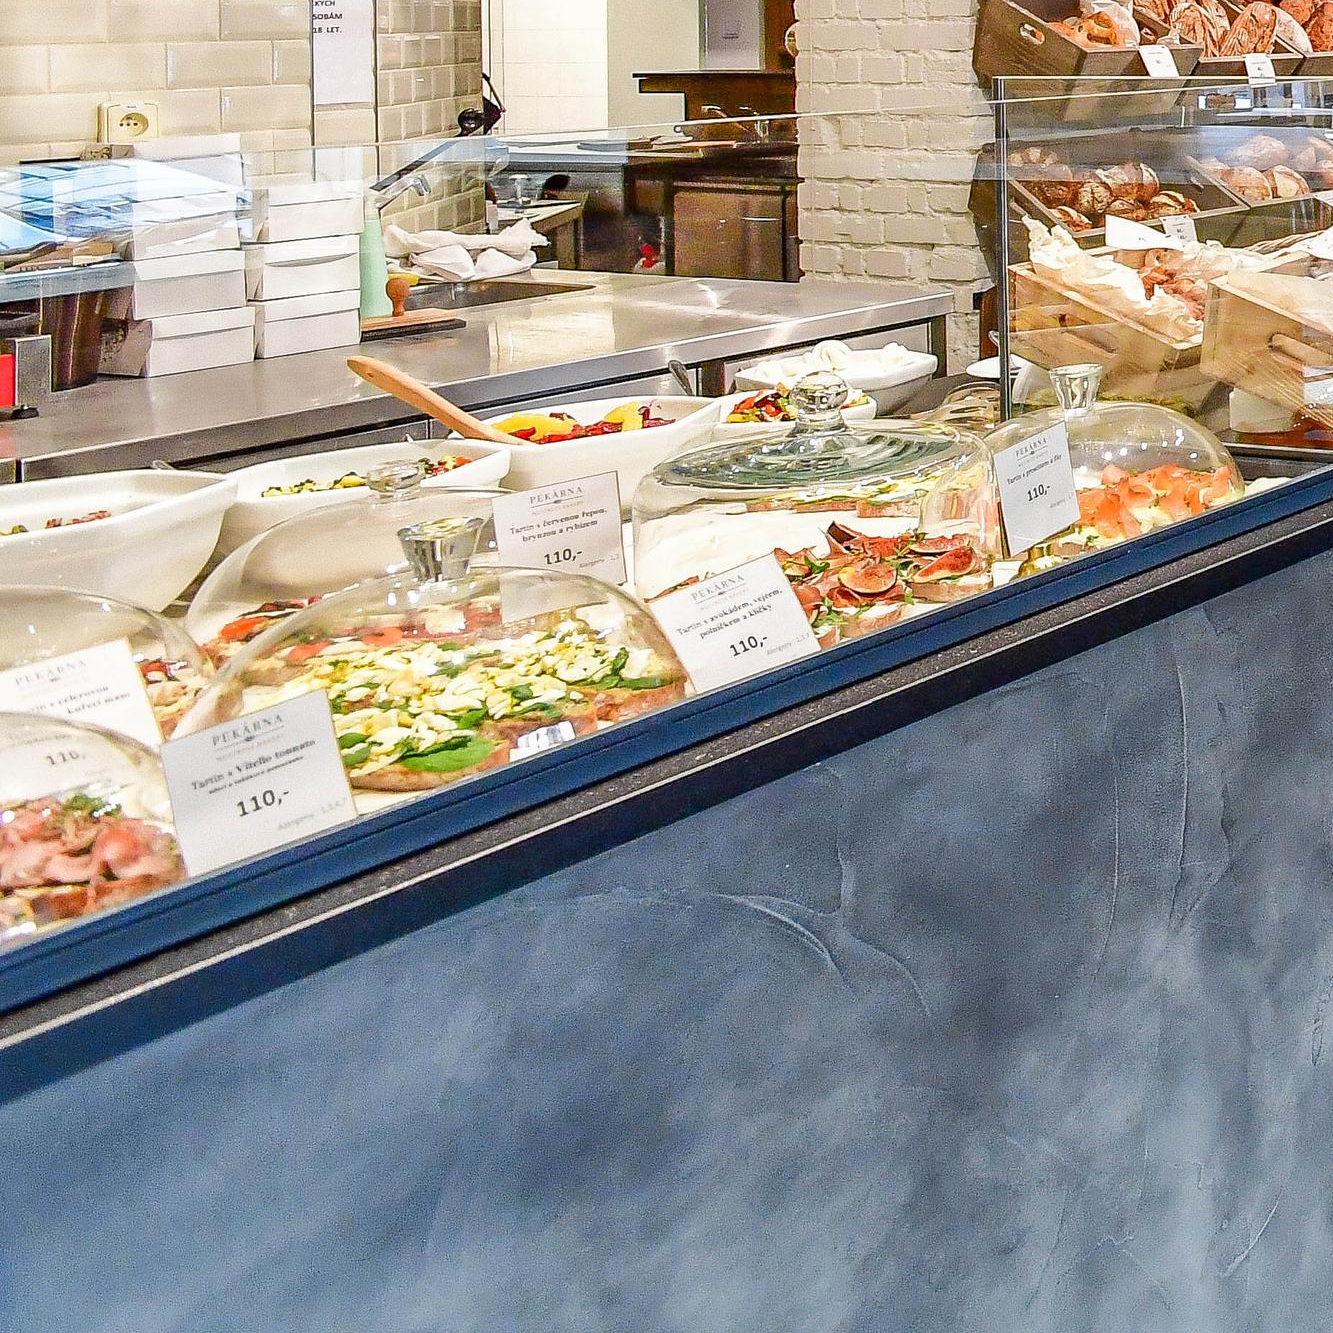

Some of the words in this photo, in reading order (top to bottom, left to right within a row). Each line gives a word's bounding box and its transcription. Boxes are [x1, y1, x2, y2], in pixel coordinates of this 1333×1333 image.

[1026, 483, 1051, 502] 110,-
[543, 548, 583, 565] 110,-
[729, 635, 768, 657] 110,-
[235, 788, 290, 818] 110,-
